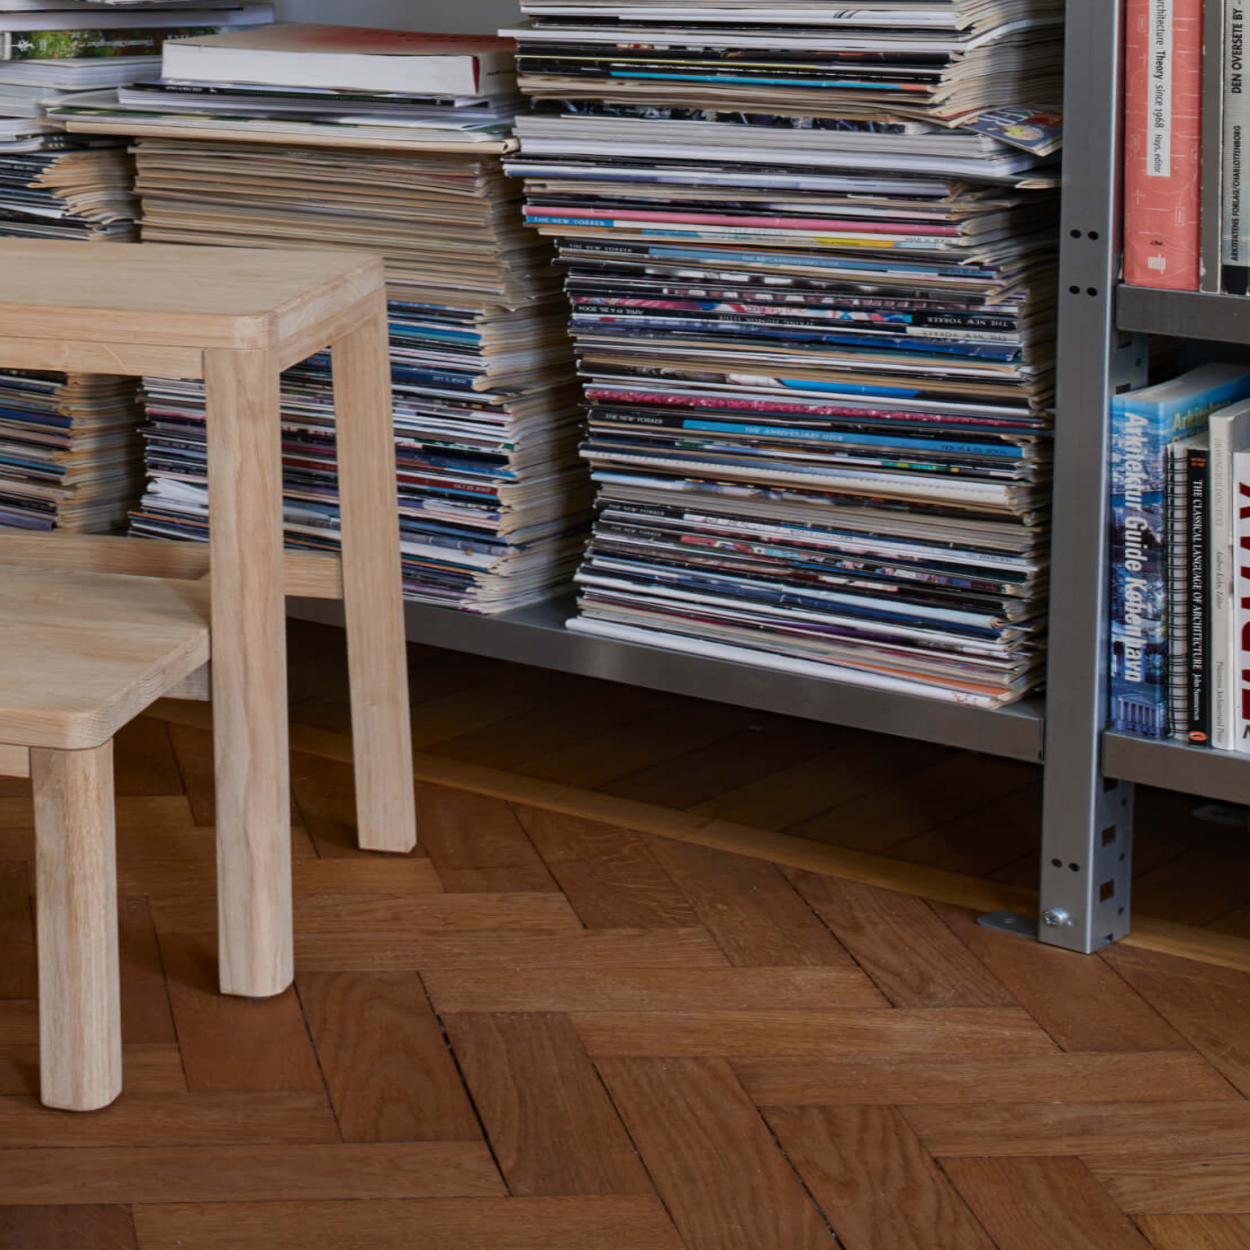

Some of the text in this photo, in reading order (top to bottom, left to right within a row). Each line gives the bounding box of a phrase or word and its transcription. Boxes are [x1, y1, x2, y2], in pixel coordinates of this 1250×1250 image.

[1232, 8, 1242, 21] BY
[1231, 23, 1242, 73] OVERSETE
[1152, 50, 1166, 80] Theory
[1231, 74, 1242, 94] DEN
[1153, 84, 1165, 106] since
[1153, 108, 1165, 129] 1968
[1152, 133, 1163, 152] Hays,
[1153, 154, 1163, 173] editor
[1123, 412, 1153, 683] Arkitektur Guide København
[1192, 480, 1203, 721] THE CLASSICAL LANGUAGE OF ARCHITECTURE John Summerson
